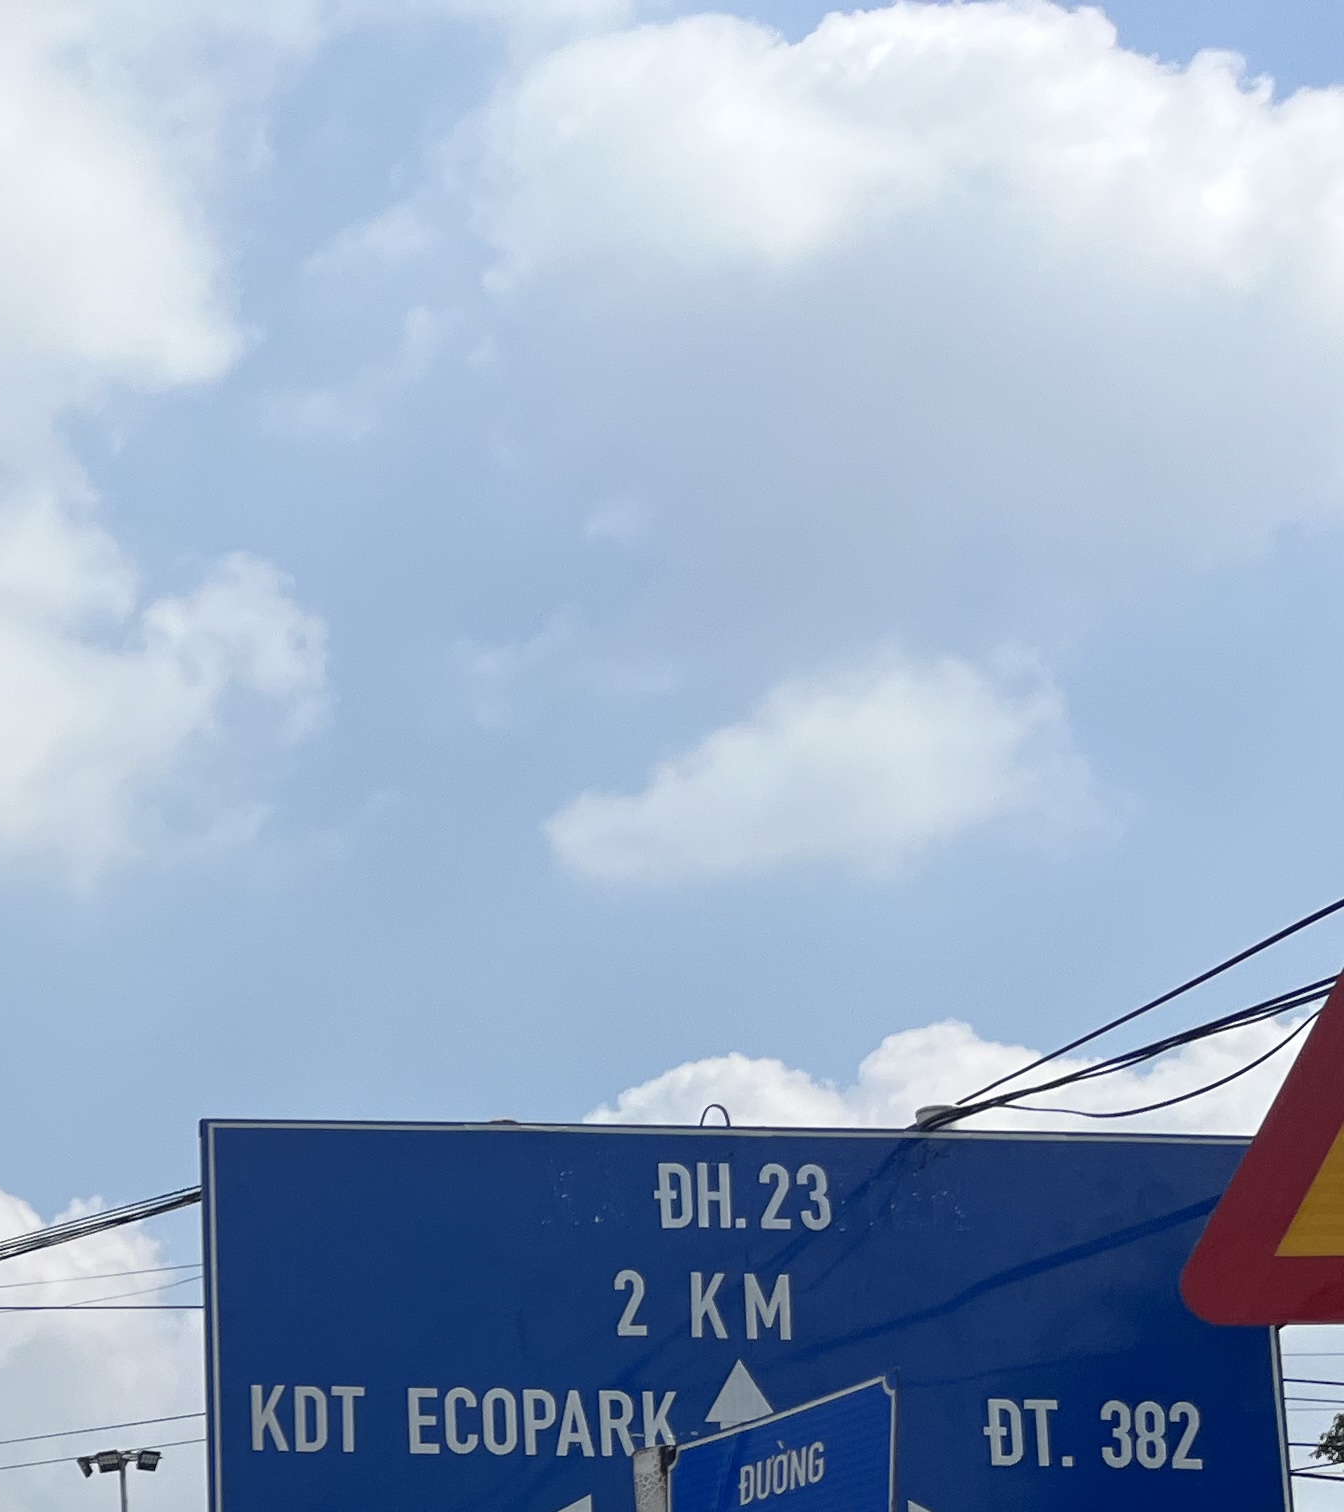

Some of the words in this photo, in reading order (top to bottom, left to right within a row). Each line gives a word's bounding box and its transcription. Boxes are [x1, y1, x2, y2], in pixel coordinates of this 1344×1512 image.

[653, 1162, 831, 1230] ĐH.23
[614, 1269, 648, 1336] 2
[691, 1272, 792, 1340] KM
[251, 1384, 365, 1453] KDT
[408, 1386, 677, 1457] ECOPARK
[983, 1398, 1073, 1467] ĐT.
[1101, 1400, 1203, 1470] 382
[738, 1440, 825, 1506] ĐƯỜNG
